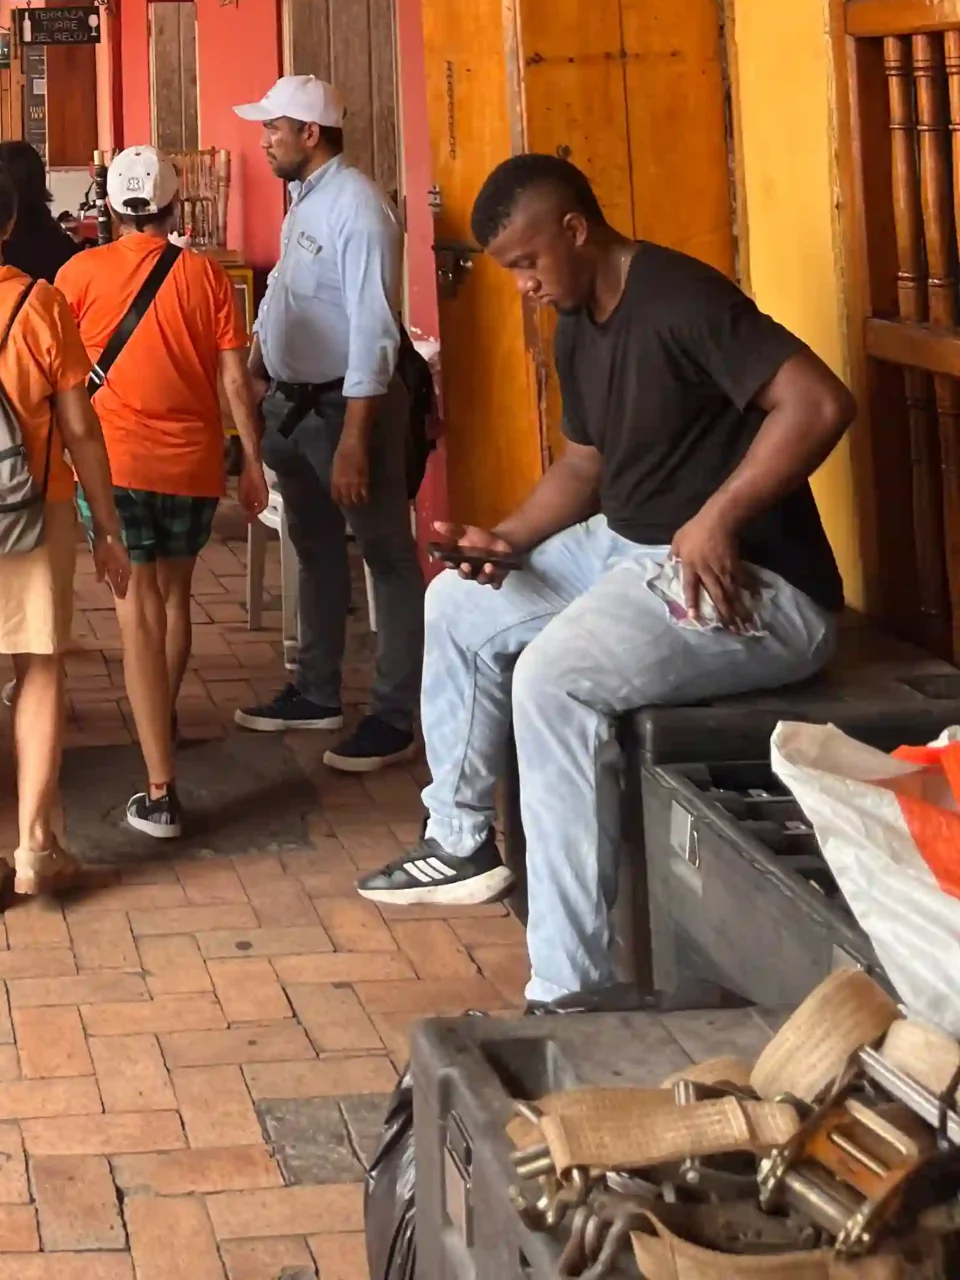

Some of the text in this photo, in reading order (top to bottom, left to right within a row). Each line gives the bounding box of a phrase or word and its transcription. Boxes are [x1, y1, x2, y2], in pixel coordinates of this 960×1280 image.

[35, 9, 85, 20] TERRAZA
[42, 21, 79, 31] TORRE
[33, 31, 88, 43] DEL RELOJ
